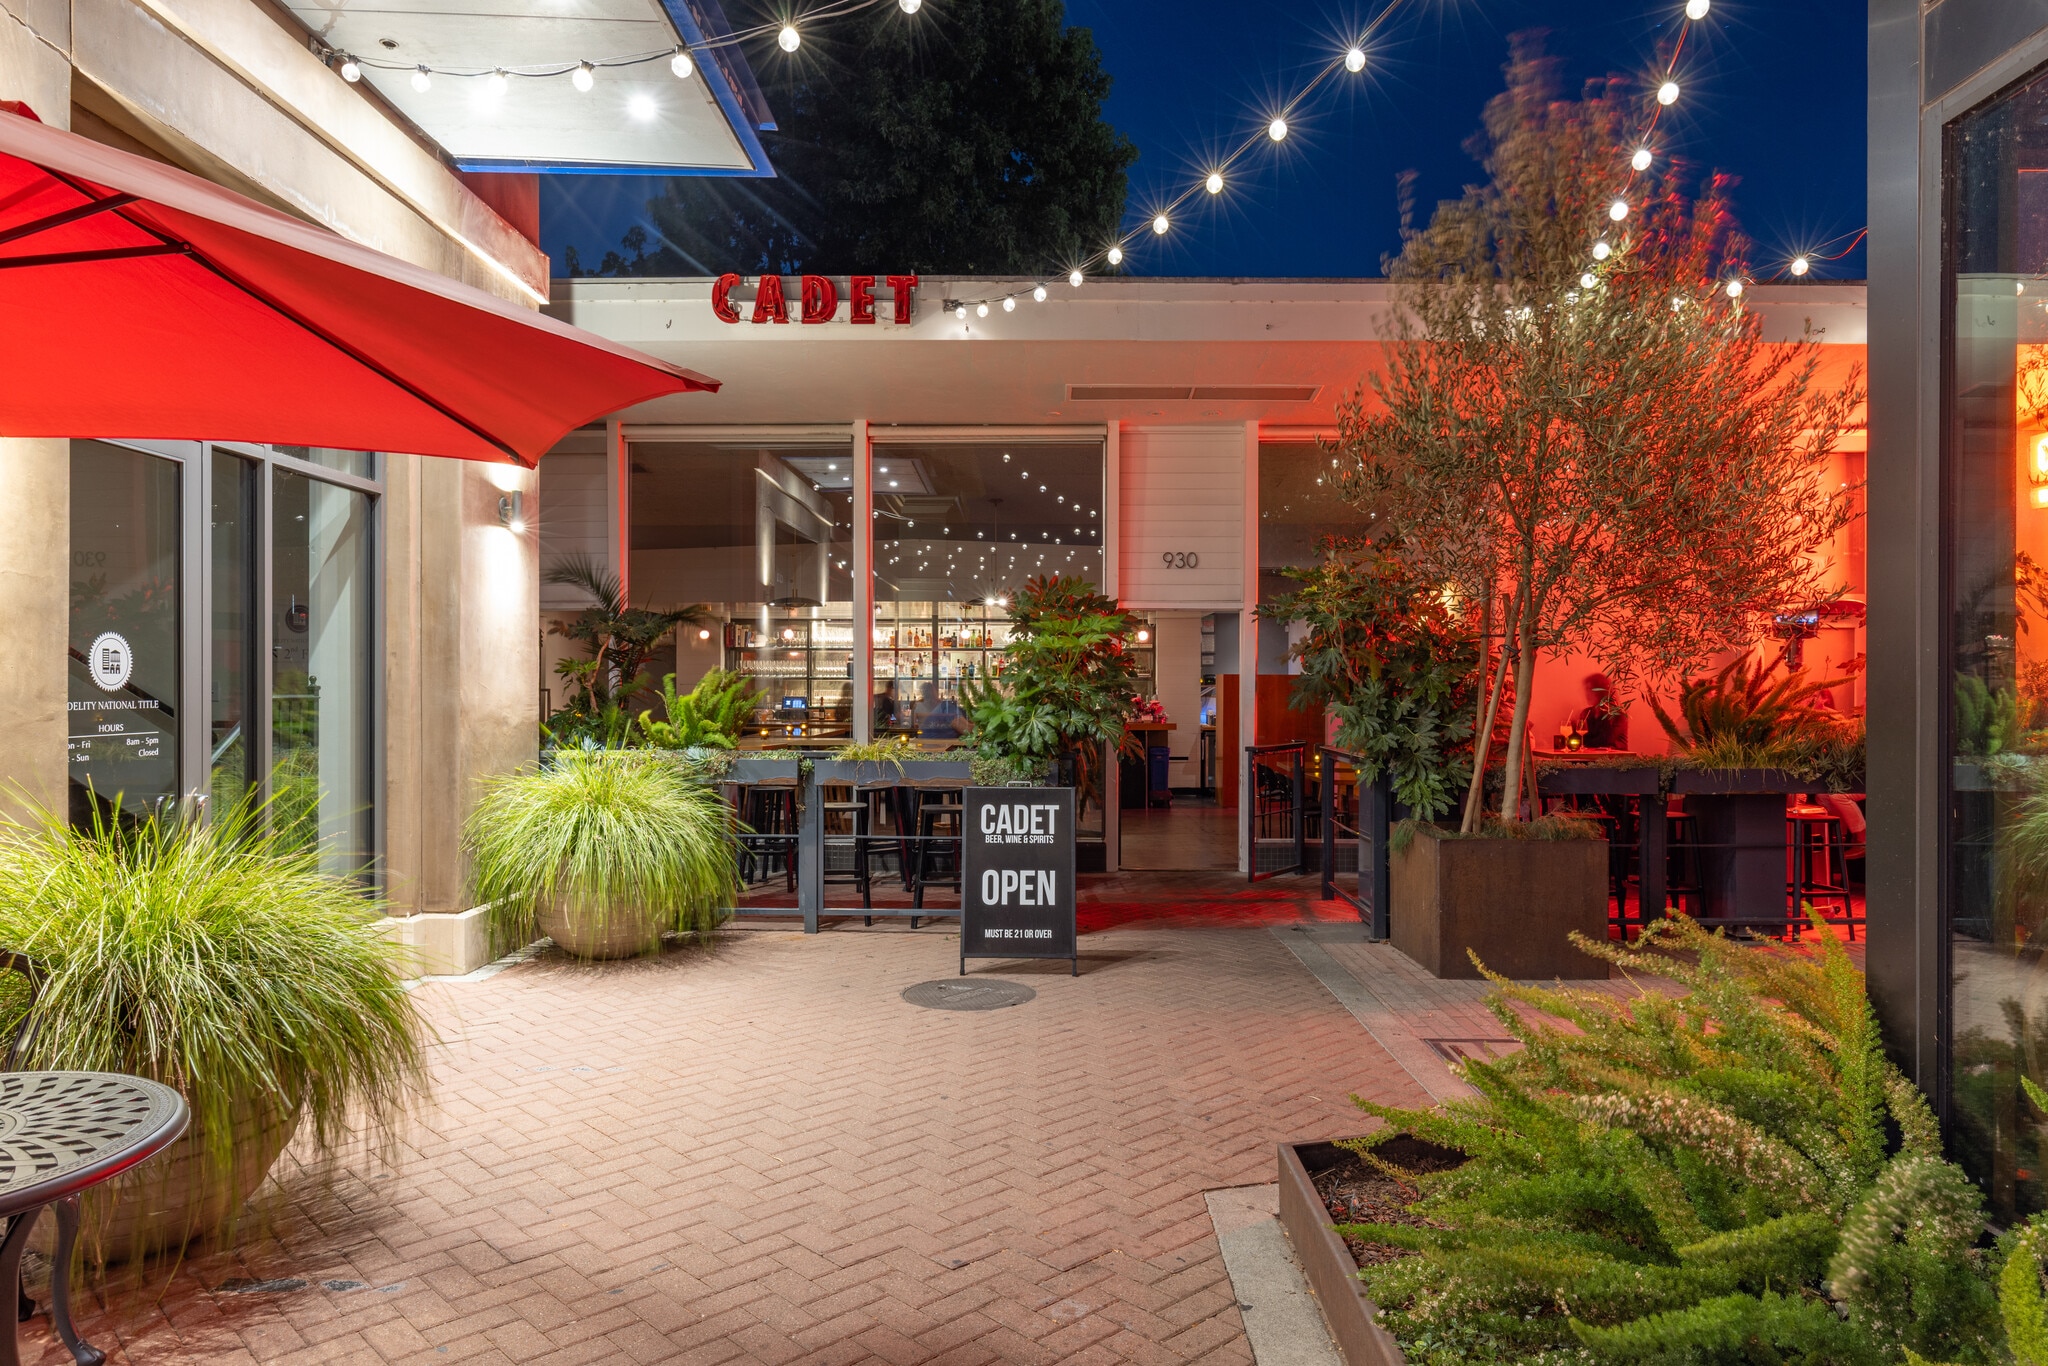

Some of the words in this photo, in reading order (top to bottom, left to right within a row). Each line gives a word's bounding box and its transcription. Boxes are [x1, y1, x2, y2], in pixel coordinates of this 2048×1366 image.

[711, 273, 918, 325] CADET
[1162, 551, 1198, 569] 930
[67, 701, 97, 711] DELITY
[98, 701, 137, 710] NATIONAL
[138, 700, 159, 709] TITLE
[98, 723, 124, 733] HOURS
[81, 740, 91, 749] Fri
[126, 738, 140, 746] 8am
[145, 737, 159, 747] 5pm
[138, 747, 159, 757] Closed
[76, 753, 90, 762] Sun
[980, 803, 1060, 835] CADET
[985, 834, 1004, 844] BEER,
[1005, 834, 1022, 844] WINE
[1023, 834, 1028, 844] &
[1029, 834, 1054, 844] SPIRITS
[981, 869, 1056, 906] OPEN
[984, 928, 1003, 938] MUST
[1004, 929, 1013, 938] BE
[1014, 929, 1023, 939] 21
[1024, 929, 1034, 939] OR
[1034, 929, 1053, 939] OVER
